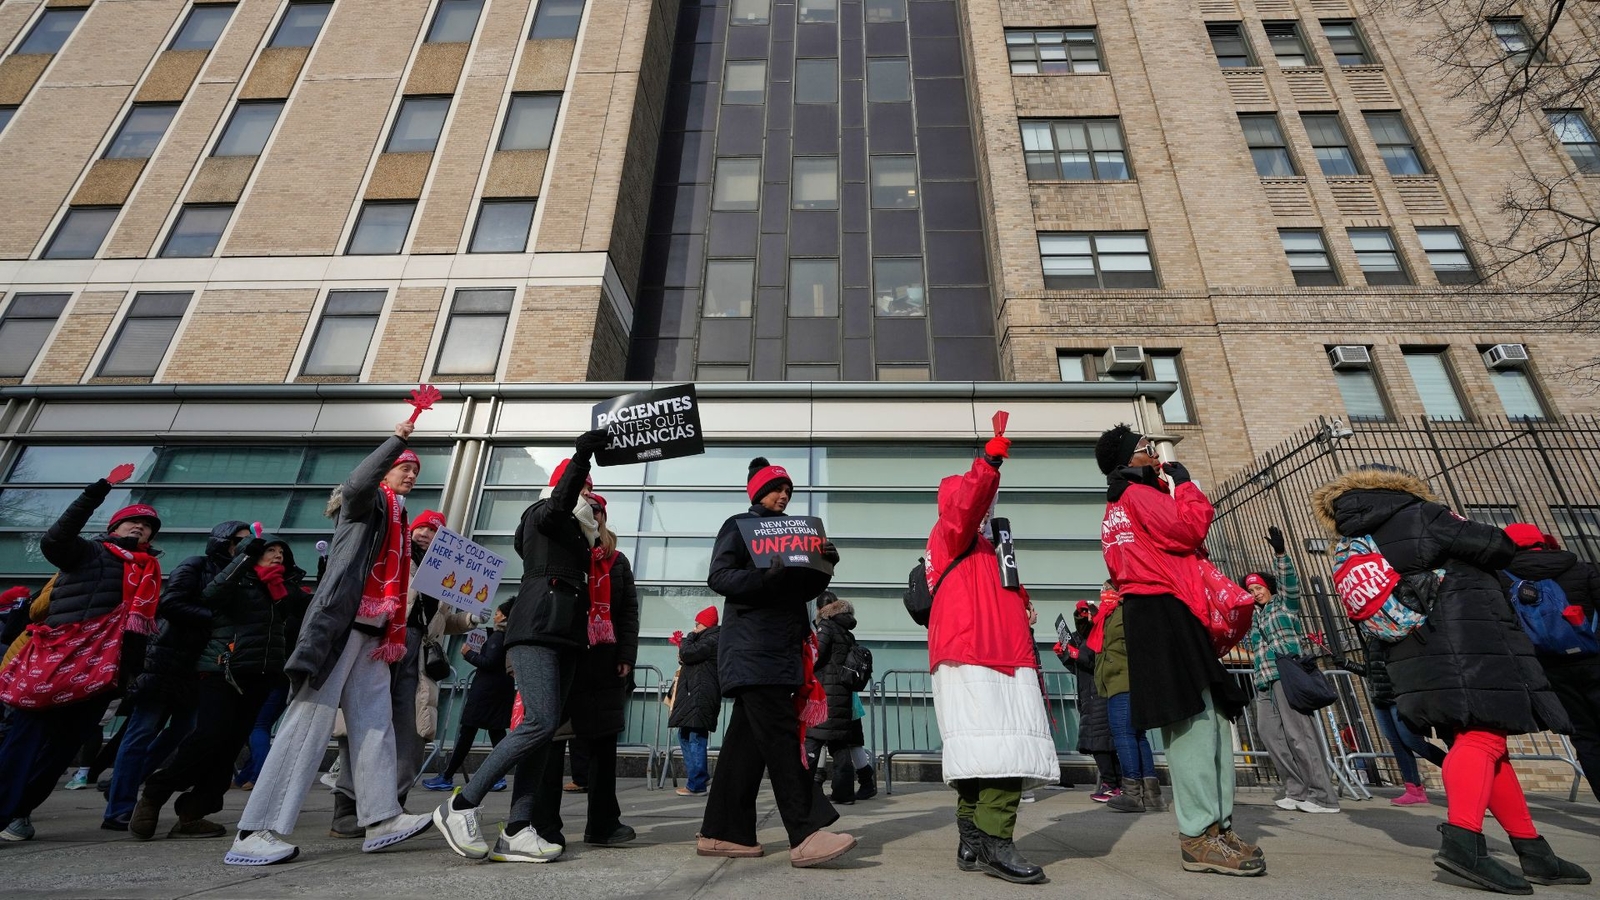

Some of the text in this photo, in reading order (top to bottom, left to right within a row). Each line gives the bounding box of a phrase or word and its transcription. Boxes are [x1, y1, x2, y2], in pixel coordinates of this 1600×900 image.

[597, 396, 692, 427] PACIENTES
[607, 413, 686, 436] ANTES QUE
[754, 527, 818, 537] PRESBYTERIAN
[760, 521, 781, 529] NEW
[438, 530, 504, 568] IT'S COLD OUT
[751, 534, 827, 555] UNFAIR!
[426, 556, 442, 570] ARE
[432, 543, 497, 580] HERE BUT WE
[441, 589, 455, 600] DAY
[1346, 572, 1390, 614] NOW!!
